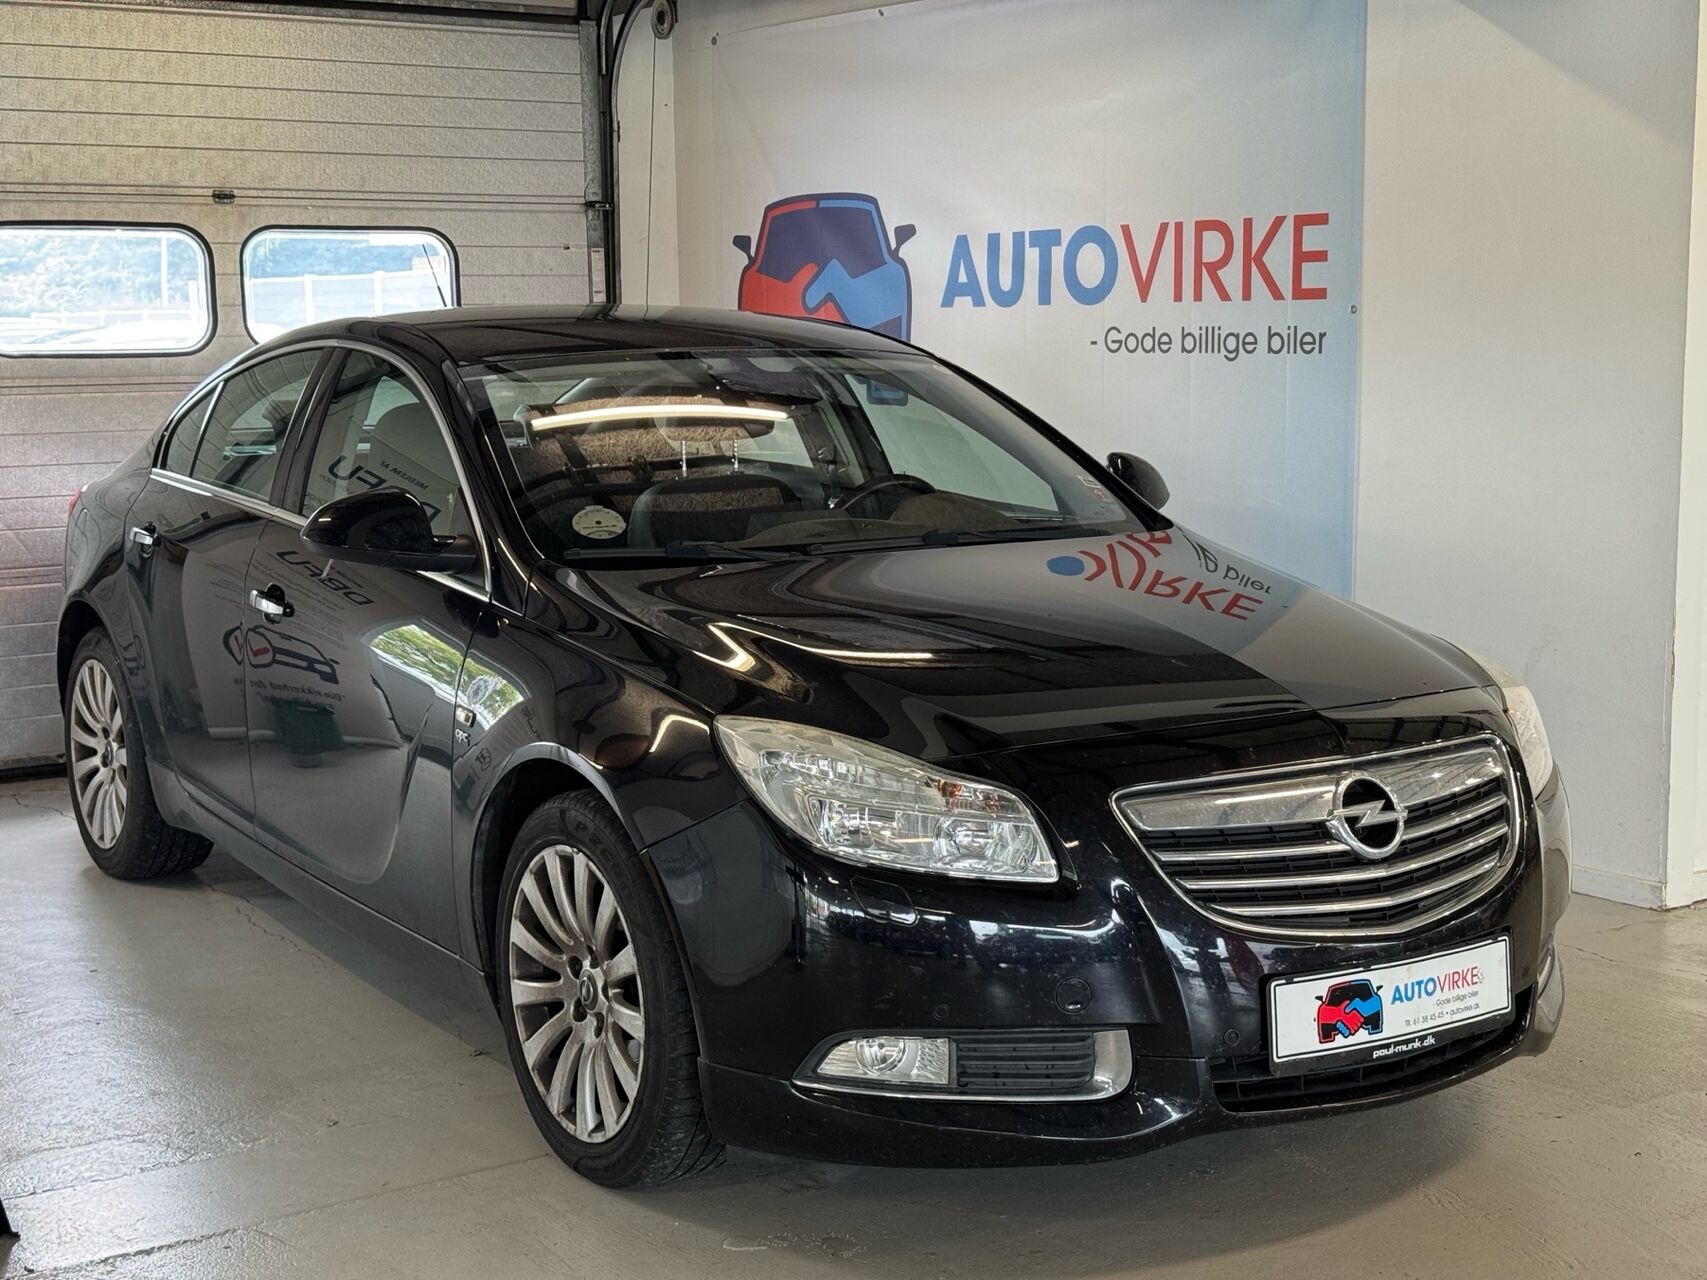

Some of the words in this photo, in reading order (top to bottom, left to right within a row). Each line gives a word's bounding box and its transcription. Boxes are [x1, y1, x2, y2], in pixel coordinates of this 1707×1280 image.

[940, 212, 1329, 308] AUTOVIRKE
[1181, 326, 1258, 362] billige
[1267, 325, 1327, 354] biler
[1391, 966, 1478, 1005] AUTOVIRKE
